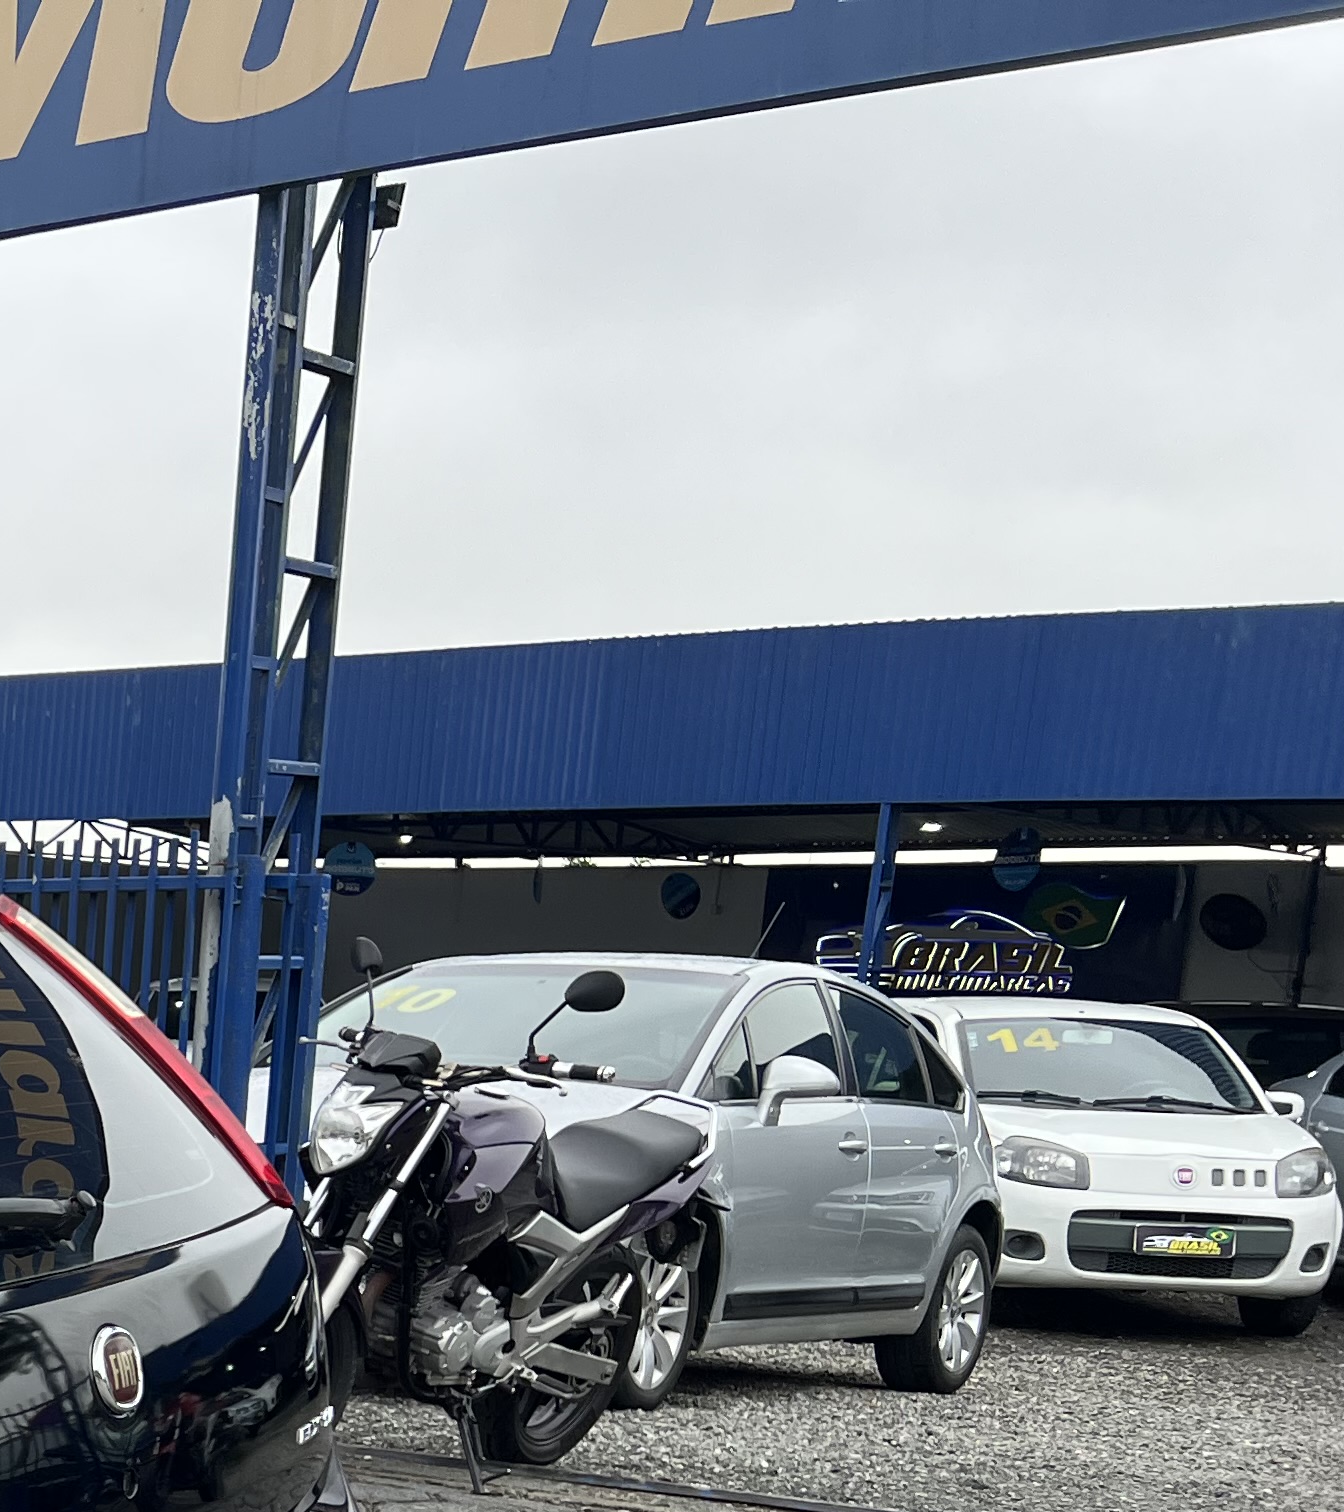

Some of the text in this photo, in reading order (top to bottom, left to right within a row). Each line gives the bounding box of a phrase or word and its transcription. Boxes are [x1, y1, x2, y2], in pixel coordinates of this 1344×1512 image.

[895, 940, 1074, 974] BRASIL
[986, 1026, 1061, 1054] 14
[108, 1348, 138, 1391] FIAT
